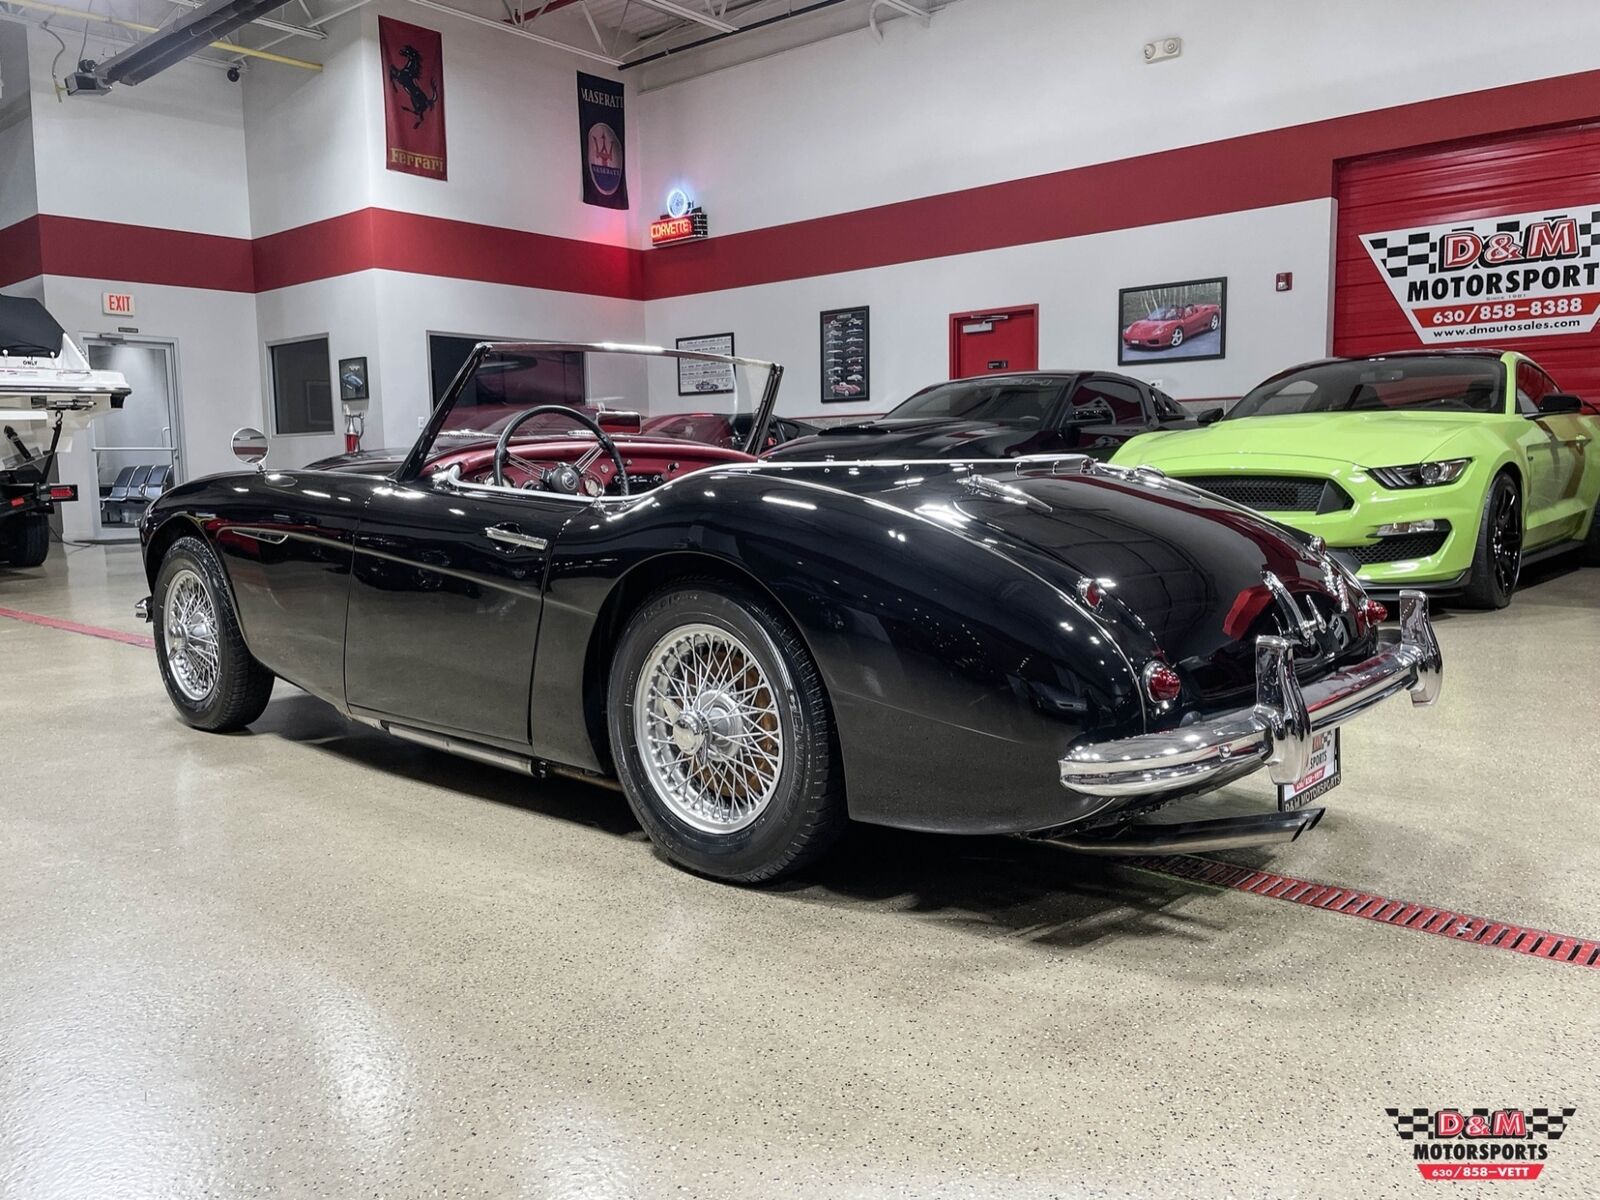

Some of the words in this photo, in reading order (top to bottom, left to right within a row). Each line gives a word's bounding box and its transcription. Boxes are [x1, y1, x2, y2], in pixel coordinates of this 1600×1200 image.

[390, 147, 443, 172] Ferrari
[651, 219, 690, 238] CORVETTE
[1439, 218, 1580, 272] D&M
[109, 295, 130, 311] EXIT
[1432, 297, 1583, 324] 630/858-8388
[1433, 319, 1581, 338] www.dmautosales.com
